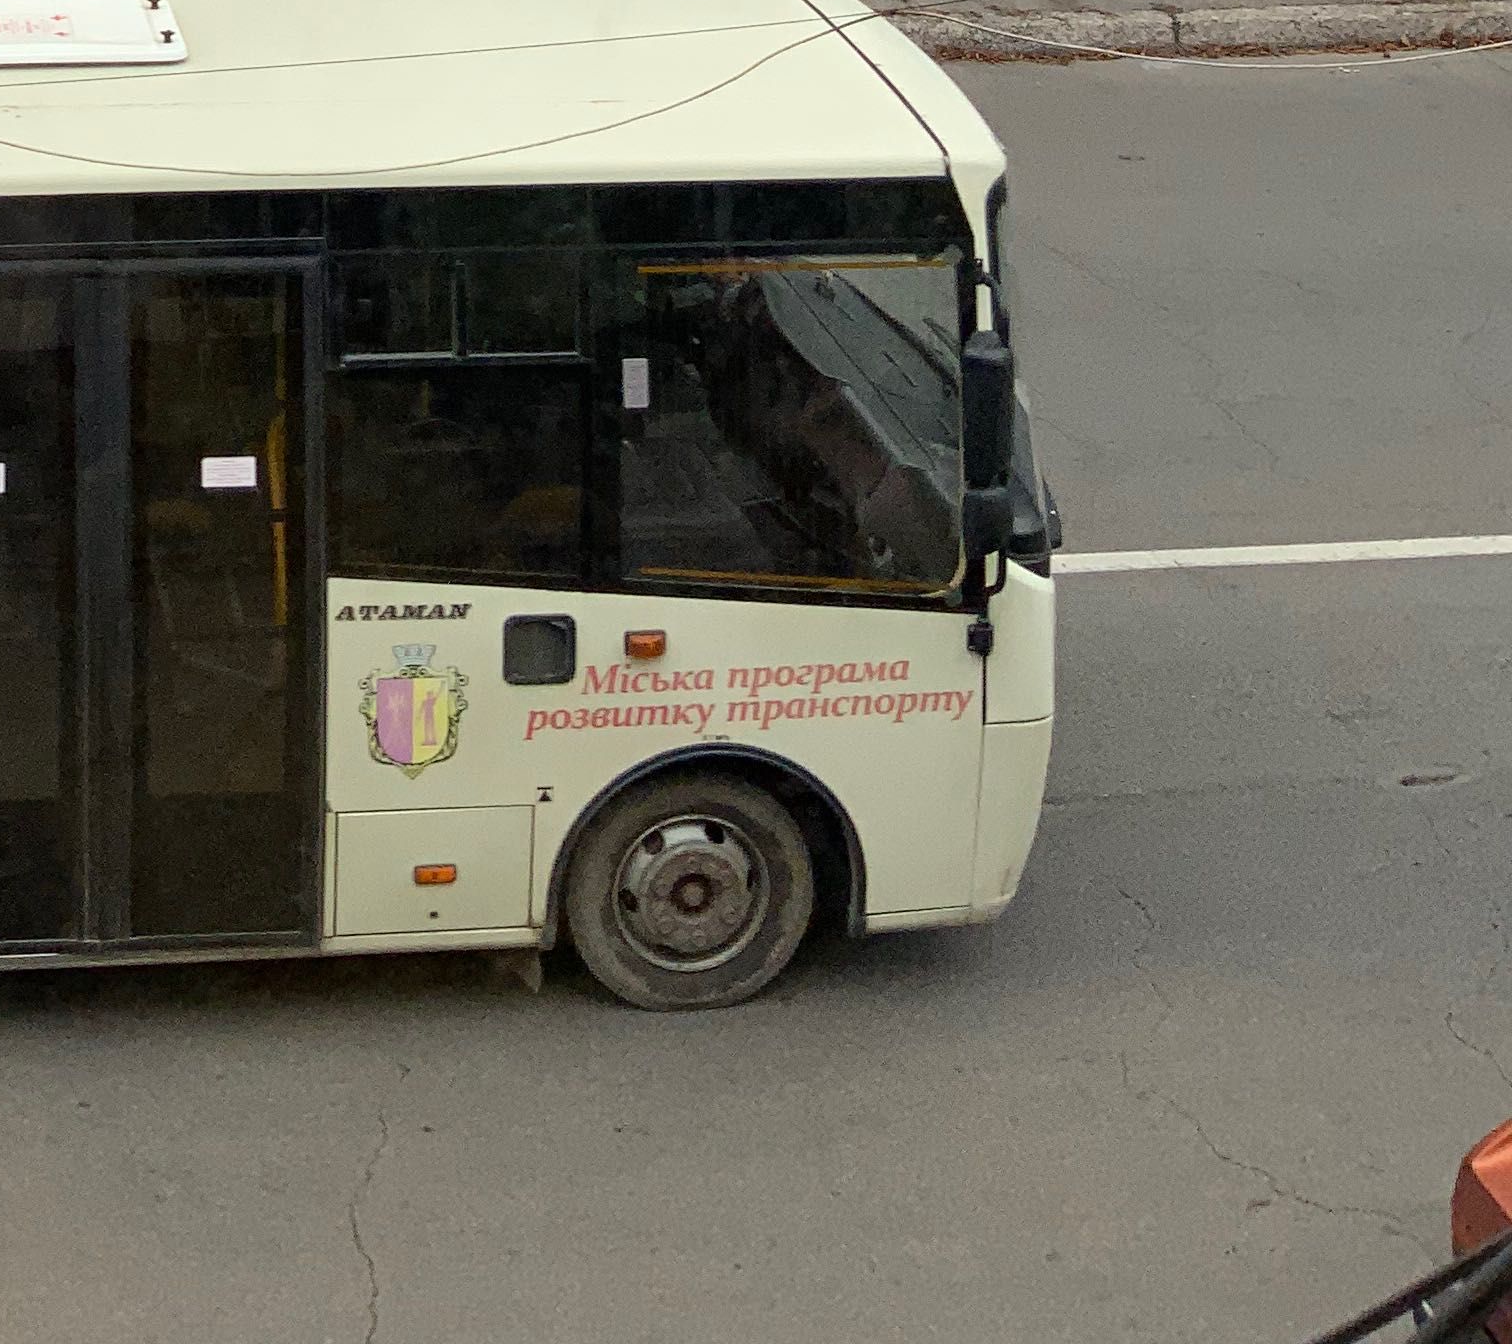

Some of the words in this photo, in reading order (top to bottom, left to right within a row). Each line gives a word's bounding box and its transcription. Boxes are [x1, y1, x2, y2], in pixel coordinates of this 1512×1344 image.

[335, 603, 472, 621] ATAMAN
[581, 663, 715, 695] Міська
[727, 660, 910, 697] програма
[523, 703, 716, 740] розвитку
[726, 690, 974, 730] транспорту
